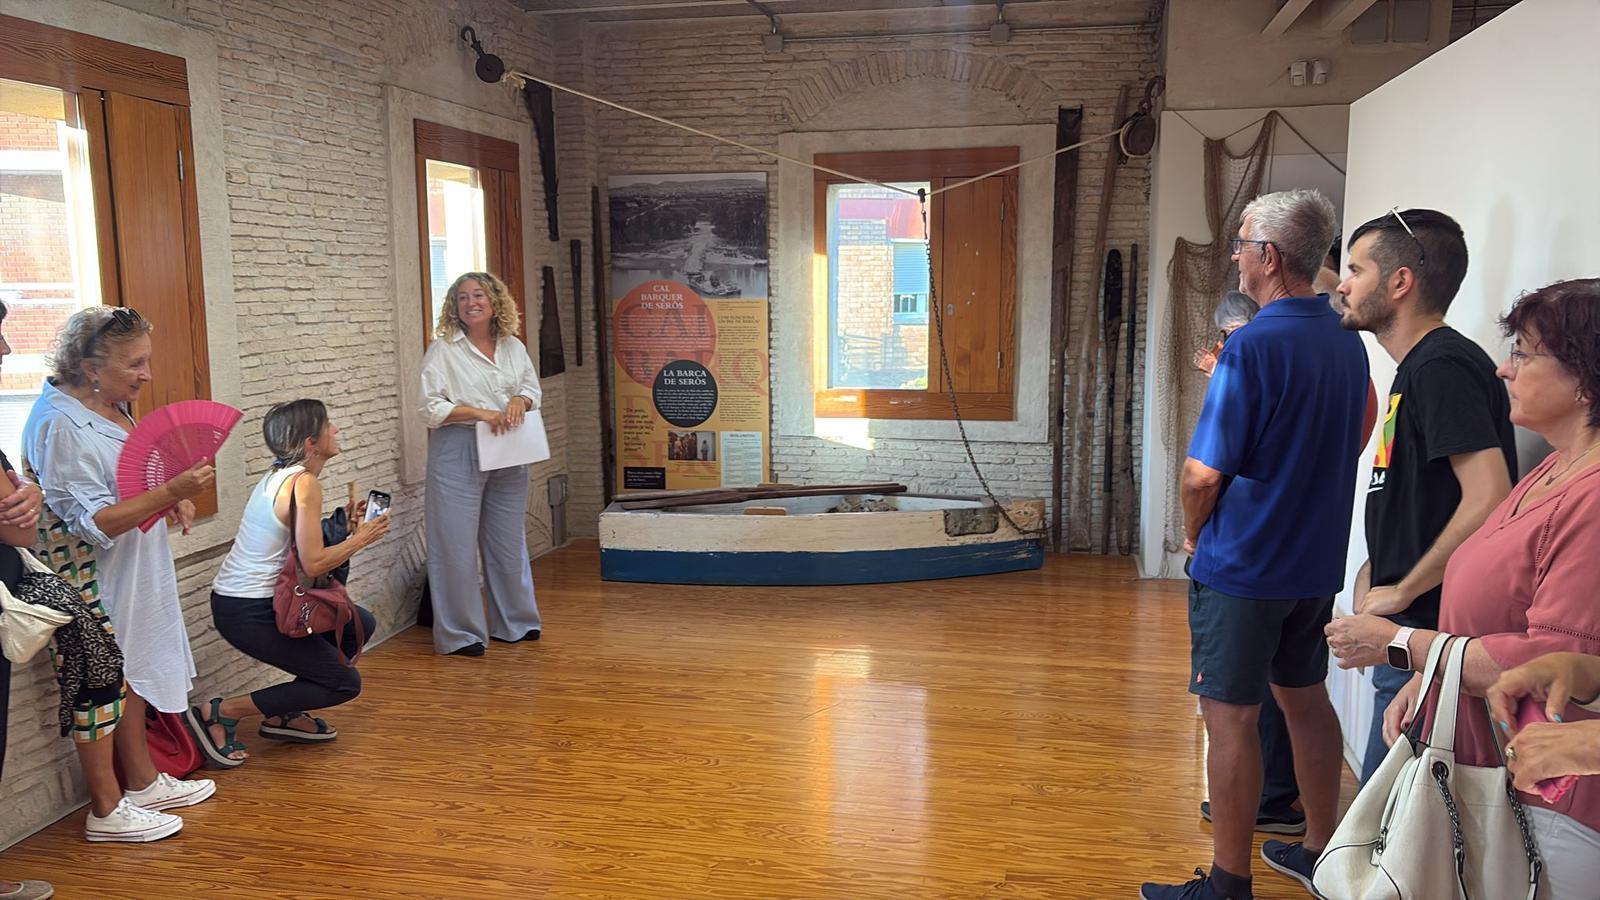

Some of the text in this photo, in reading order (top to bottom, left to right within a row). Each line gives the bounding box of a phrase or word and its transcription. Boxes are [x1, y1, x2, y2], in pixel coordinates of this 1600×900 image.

[641, 293, 684, 302] BARQUER
[641, 302, 654, 310] DE
[663, 369, 707, 377] LA BARCA
[664, 376, 707, 386] DE SERÒS
